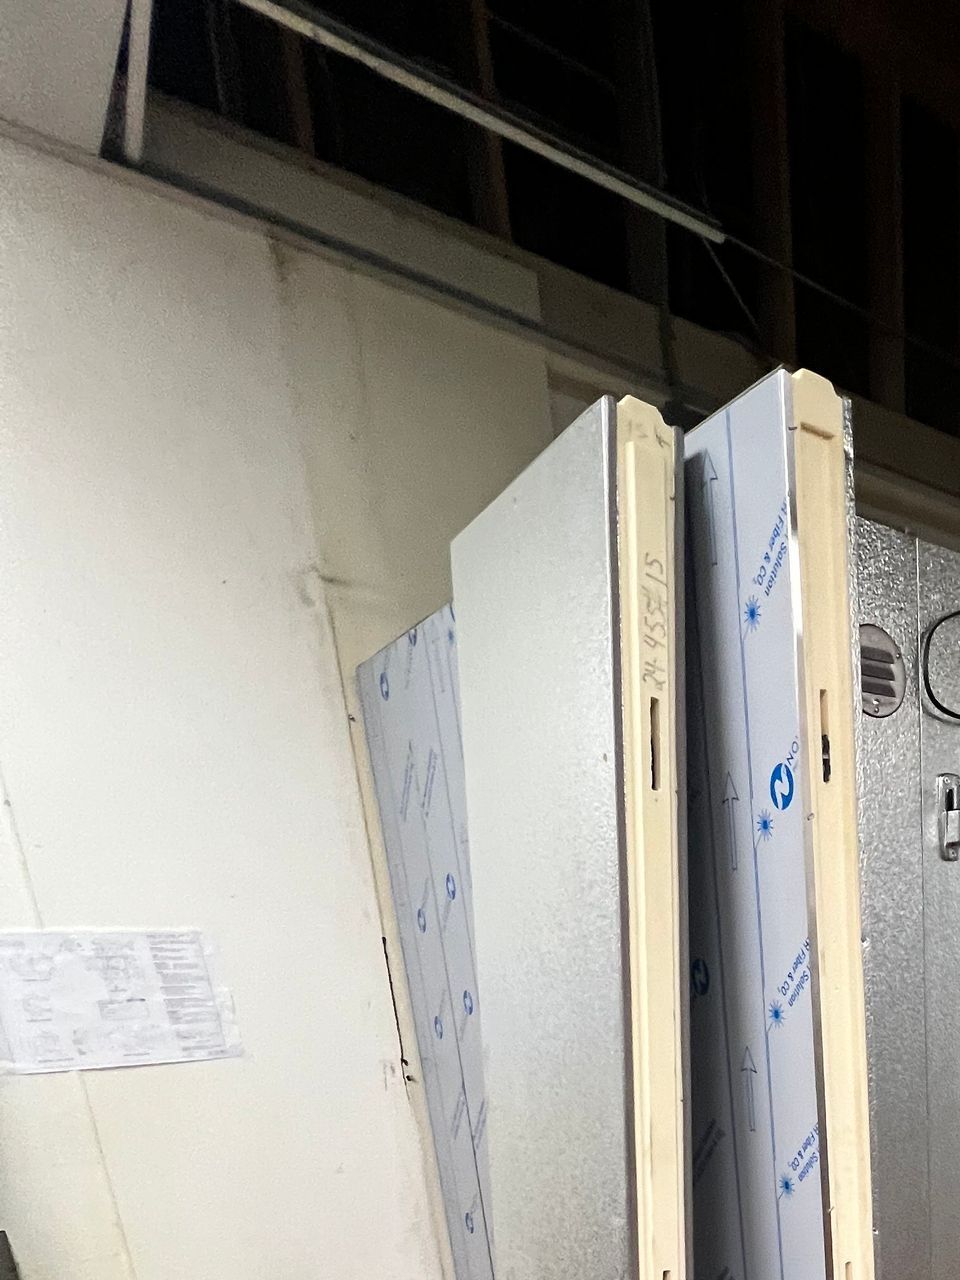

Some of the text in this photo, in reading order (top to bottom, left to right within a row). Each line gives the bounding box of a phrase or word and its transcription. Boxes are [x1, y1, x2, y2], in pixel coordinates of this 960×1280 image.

[769, 515, 785, 552] Fiber
[764, 541, 788, 597] Solution
[788, 970, 809, 1007] Solution
